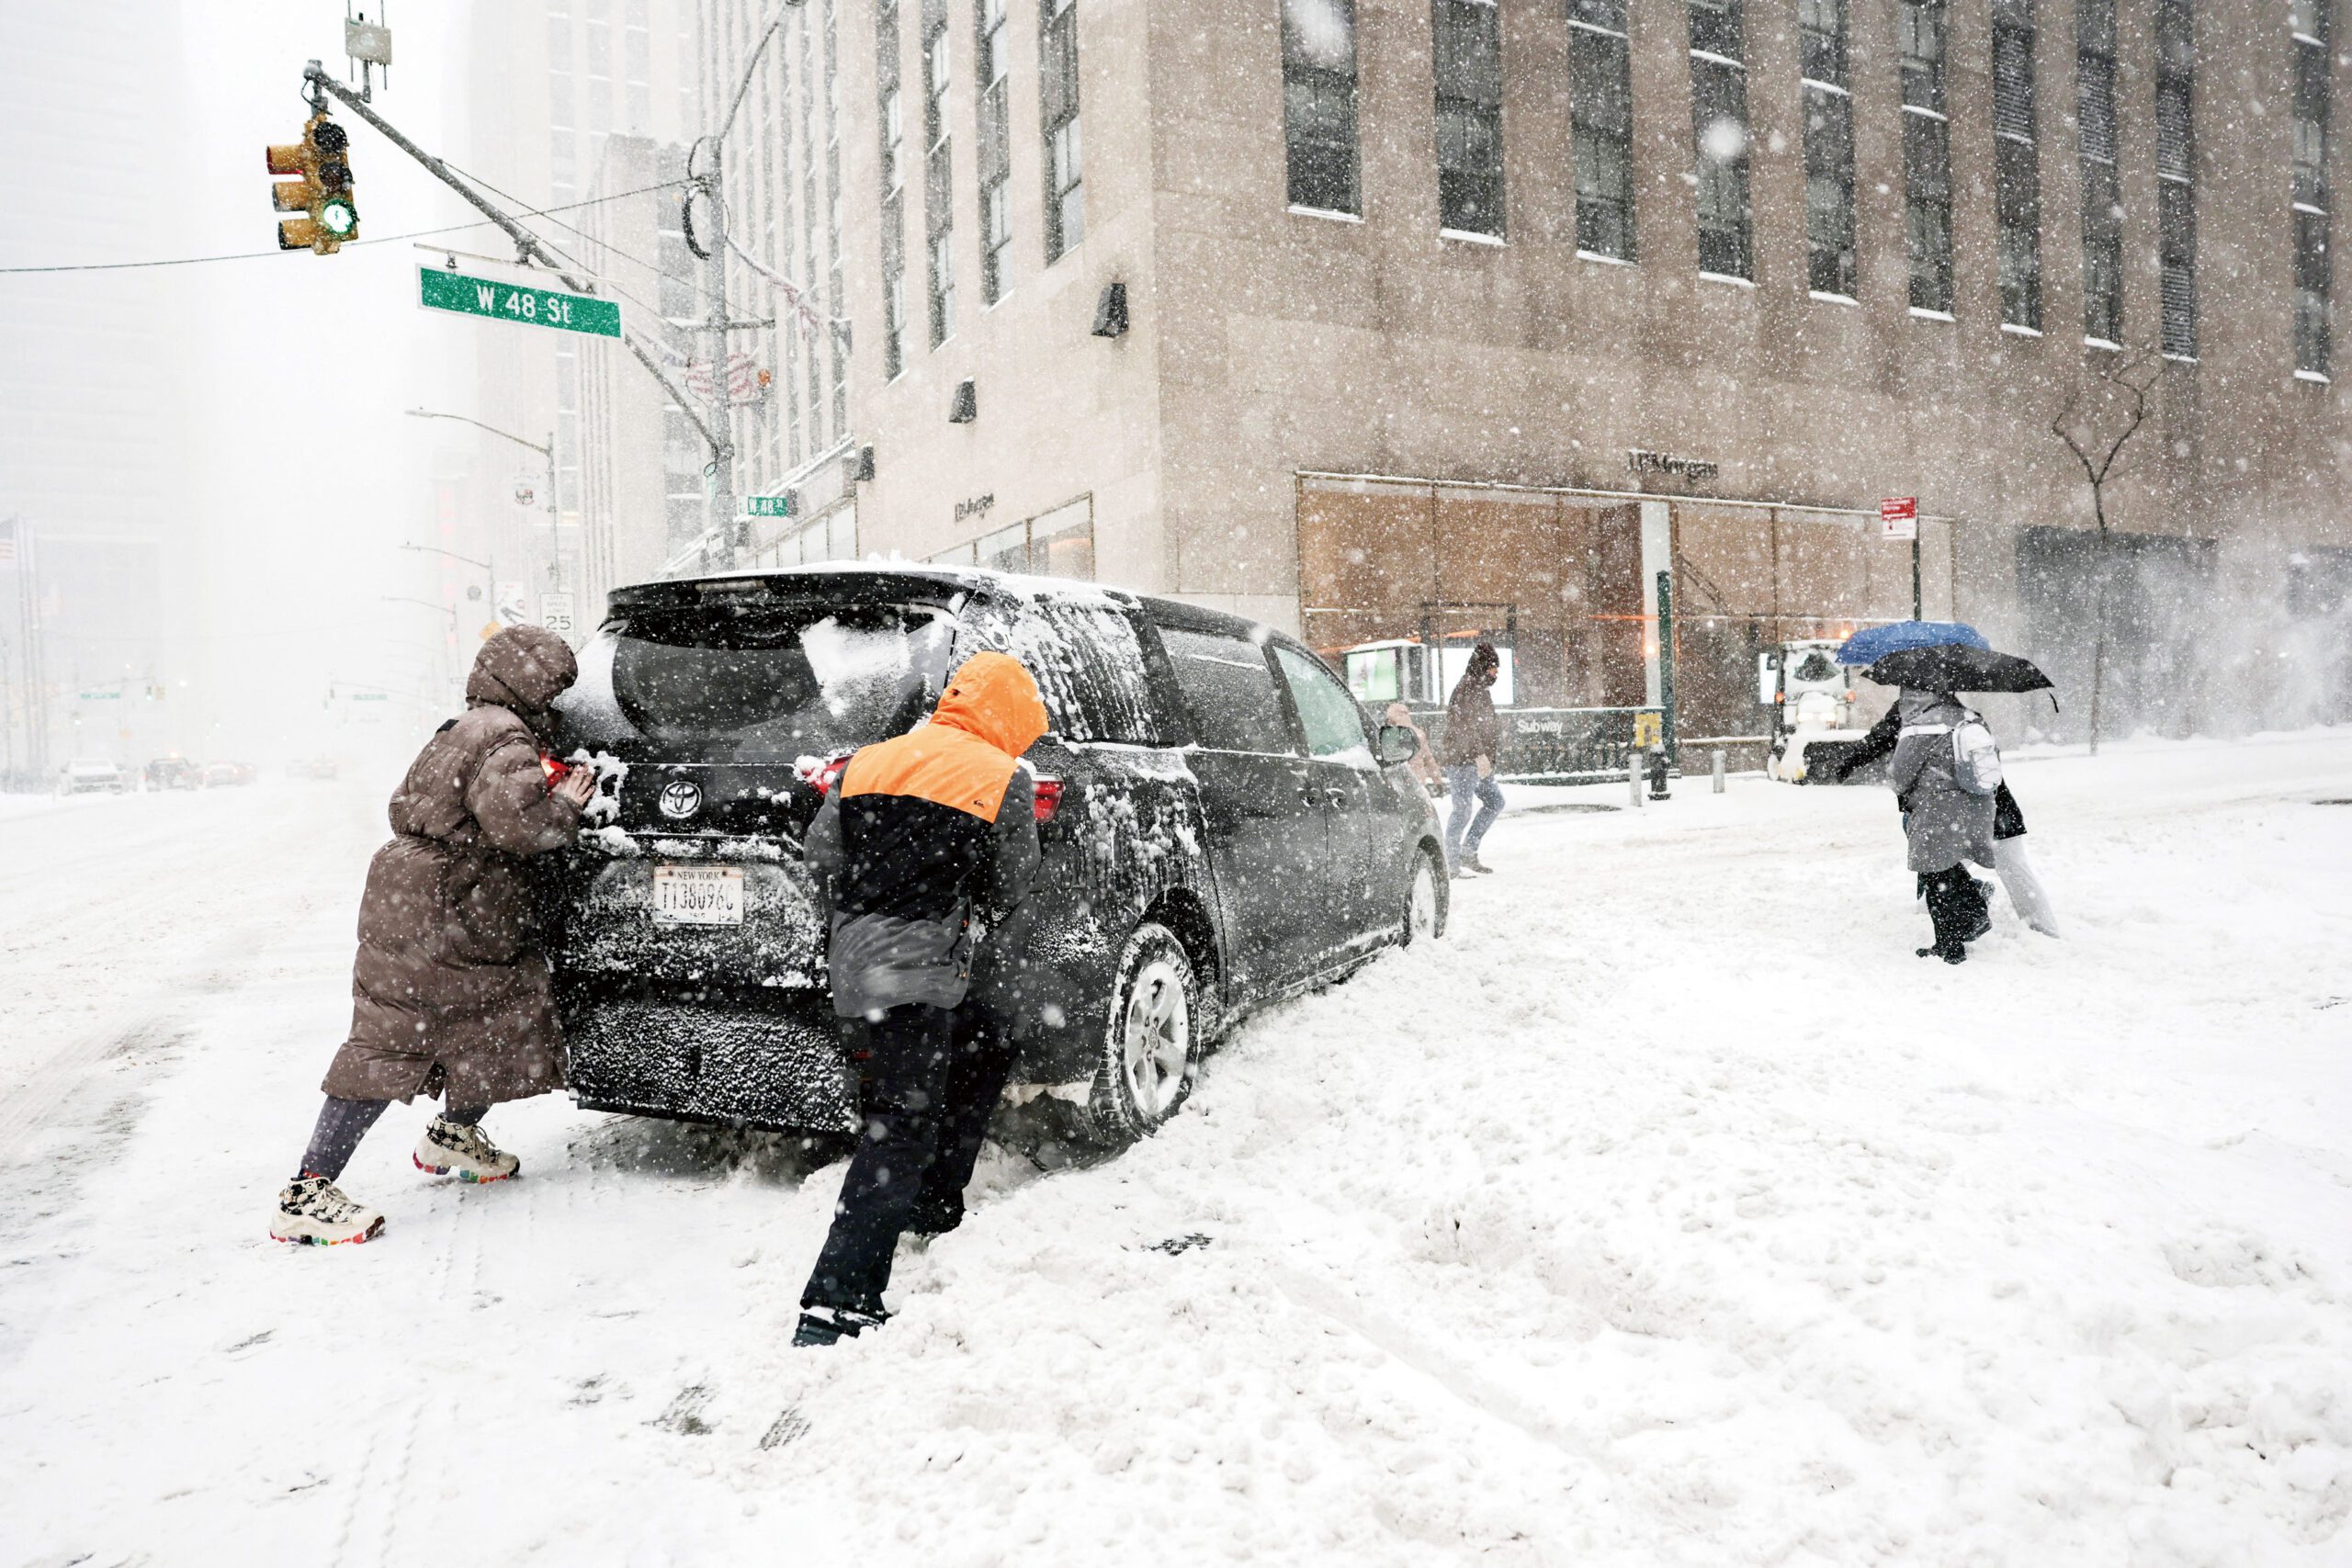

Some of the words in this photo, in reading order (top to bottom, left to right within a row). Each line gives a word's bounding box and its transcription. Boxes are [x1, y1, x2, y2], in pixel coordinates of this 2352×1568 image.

[476, 285, 495, 313] W
[505, 291, 536, 318] 48
[547, 298, 572, 324] St
[761, 499, 775, 514] 48
[546, 615, 571, 630] 25
[1517, 718, 1563, 736] Subway
[677, 871, 696, 880] NEW
[697, 871, 720, 881] YORK
